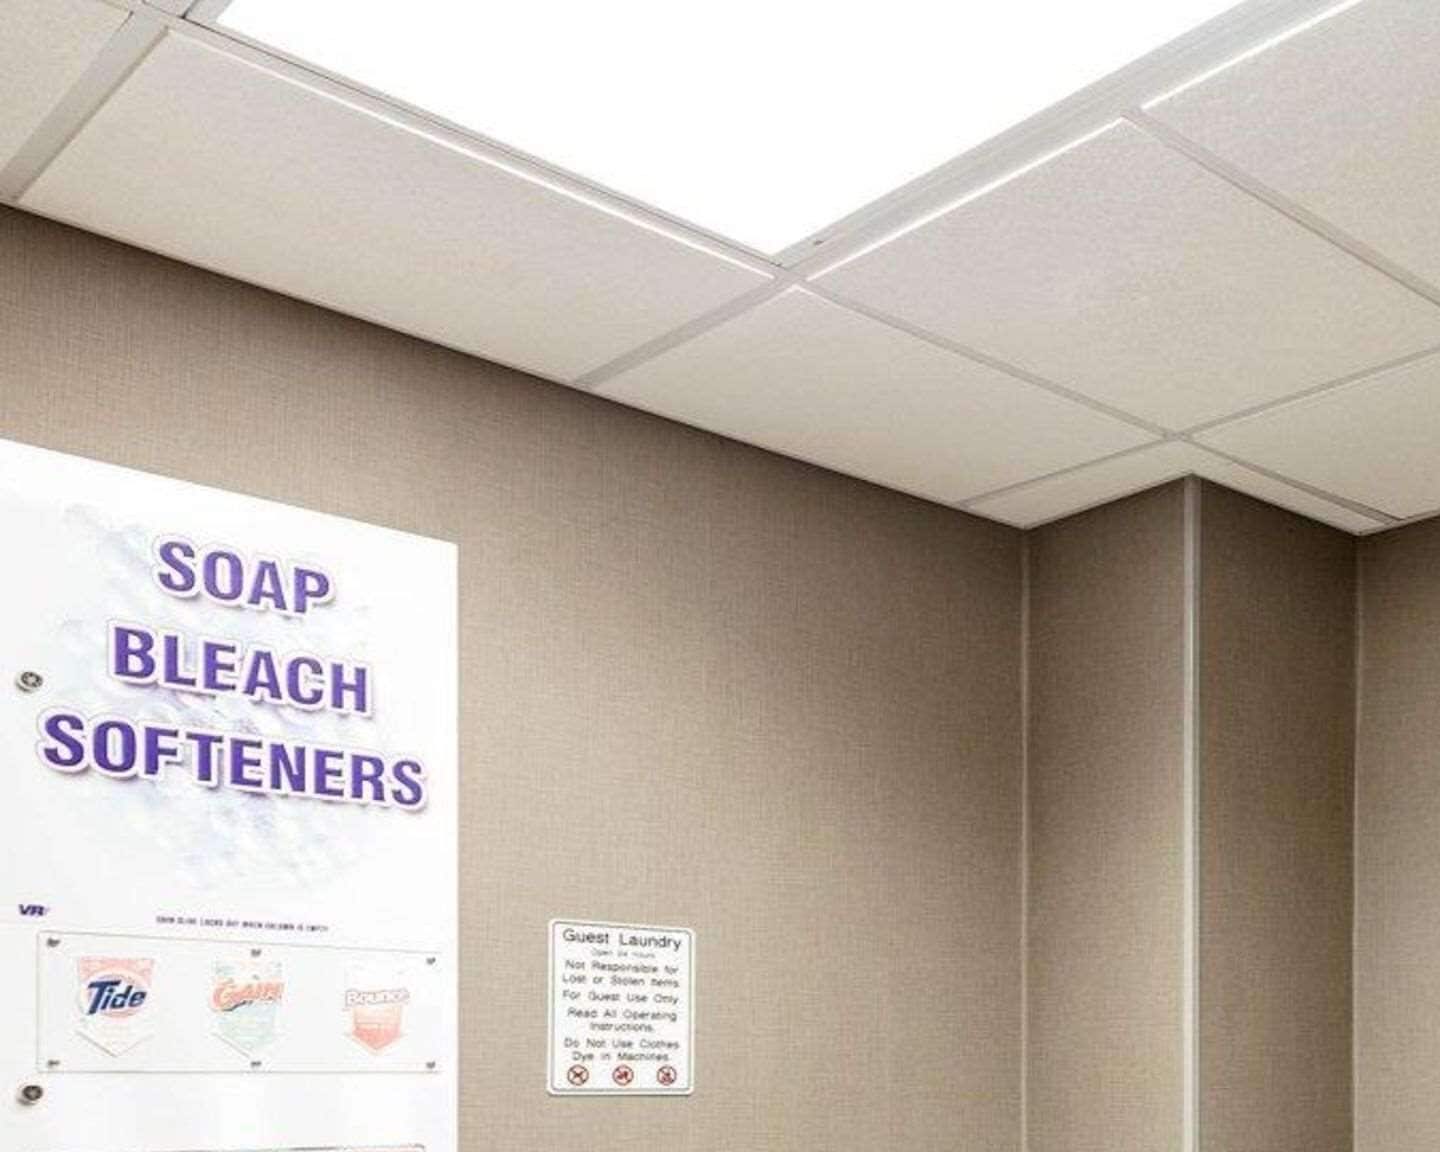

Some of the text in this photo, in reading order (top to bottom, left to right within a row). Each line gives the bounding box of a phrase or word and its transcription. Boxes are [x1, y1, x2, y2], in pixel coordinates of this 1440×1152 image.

[158, 539, 331, 614] SOAP
[113, 625, 369, 714] BLEACH
[42, 712, 426, 807] SOFTENERS
[562, 927, 682, 952] Guest Laundry
[565, 960, 679, 975] Not Responsible for
[562, 973, 680, 988] Lost or Stolen Items
[87, 978, 148, 1016] Tide
[562, 989, 679, 1005] For Guest Use Only
[567, 1007, 678, 1023] Read All Operating
[564, 1037, 680, 1049] Do Not Use Clothes
[571, 1050, 594, 1063] Dye
[601, 1052, 611, 1061] in
